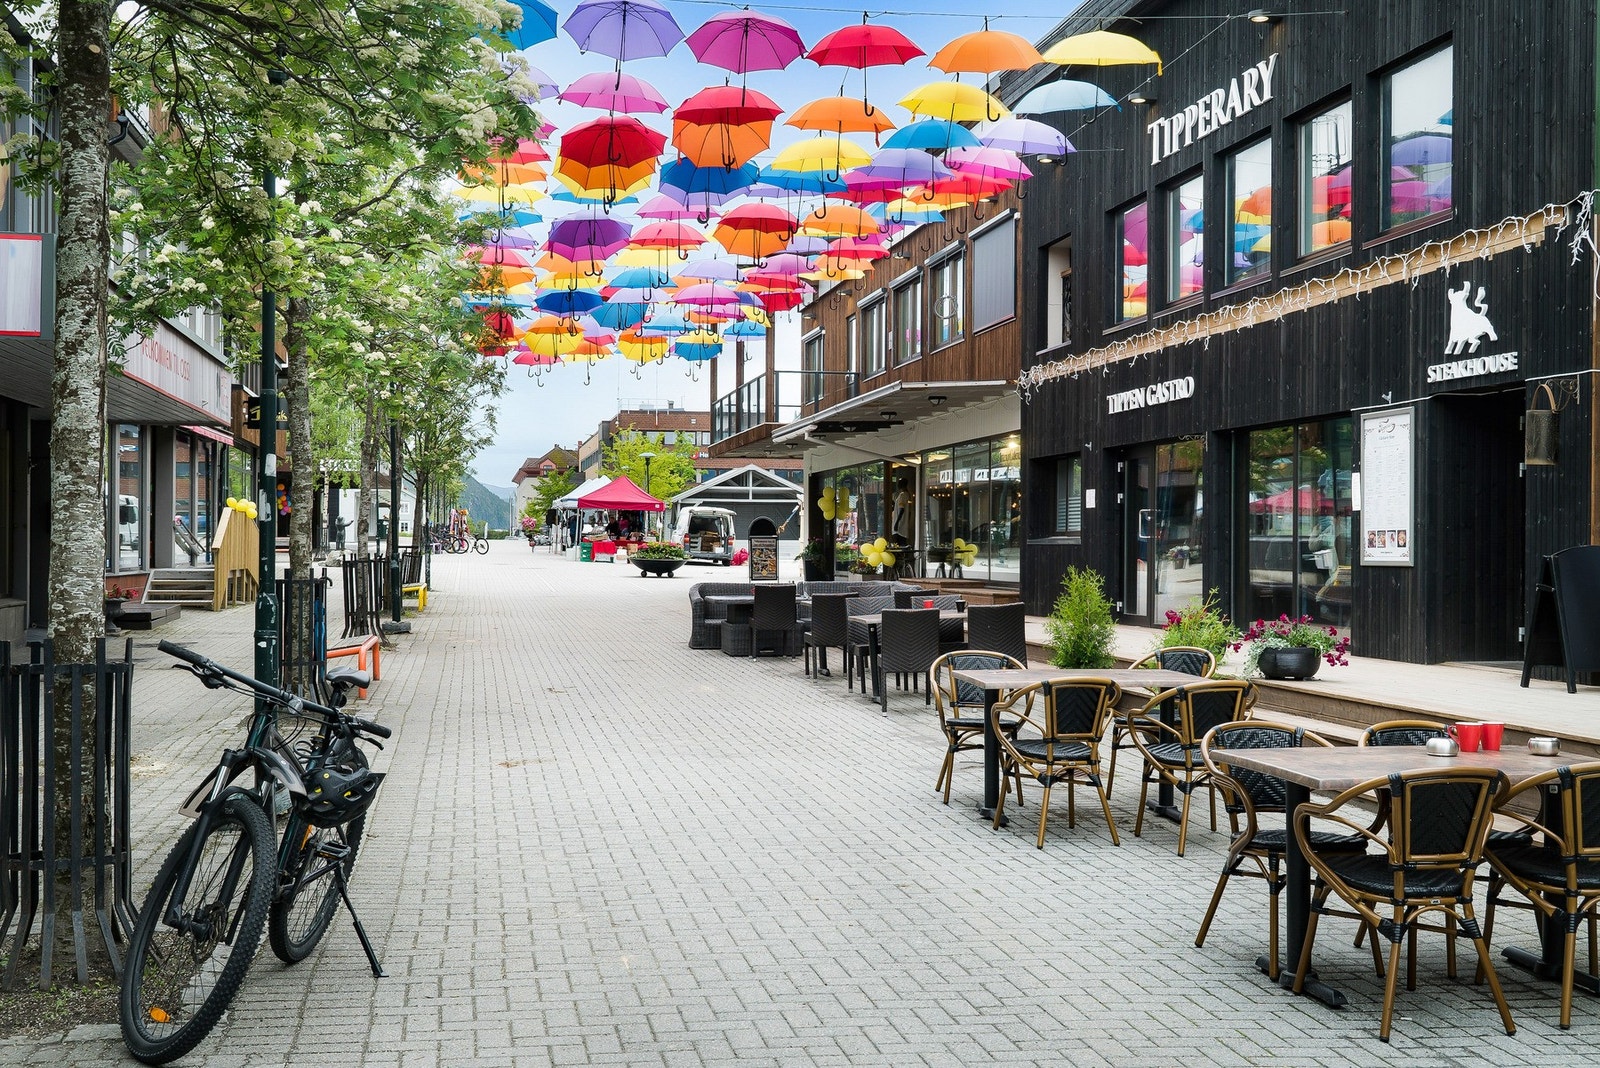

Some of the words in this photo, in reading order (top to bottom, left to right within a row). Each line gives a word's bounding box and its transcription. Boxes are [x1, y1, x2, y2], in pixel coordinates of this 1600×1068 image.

[1147, 52, 1279, 166] TIPPERARY
[1427, 351, 1519, 383] STEAKHOUSE
[1106, 387, 1146, 415] TIPPEN
[1146, 376, 1195, 406] GASTRO
